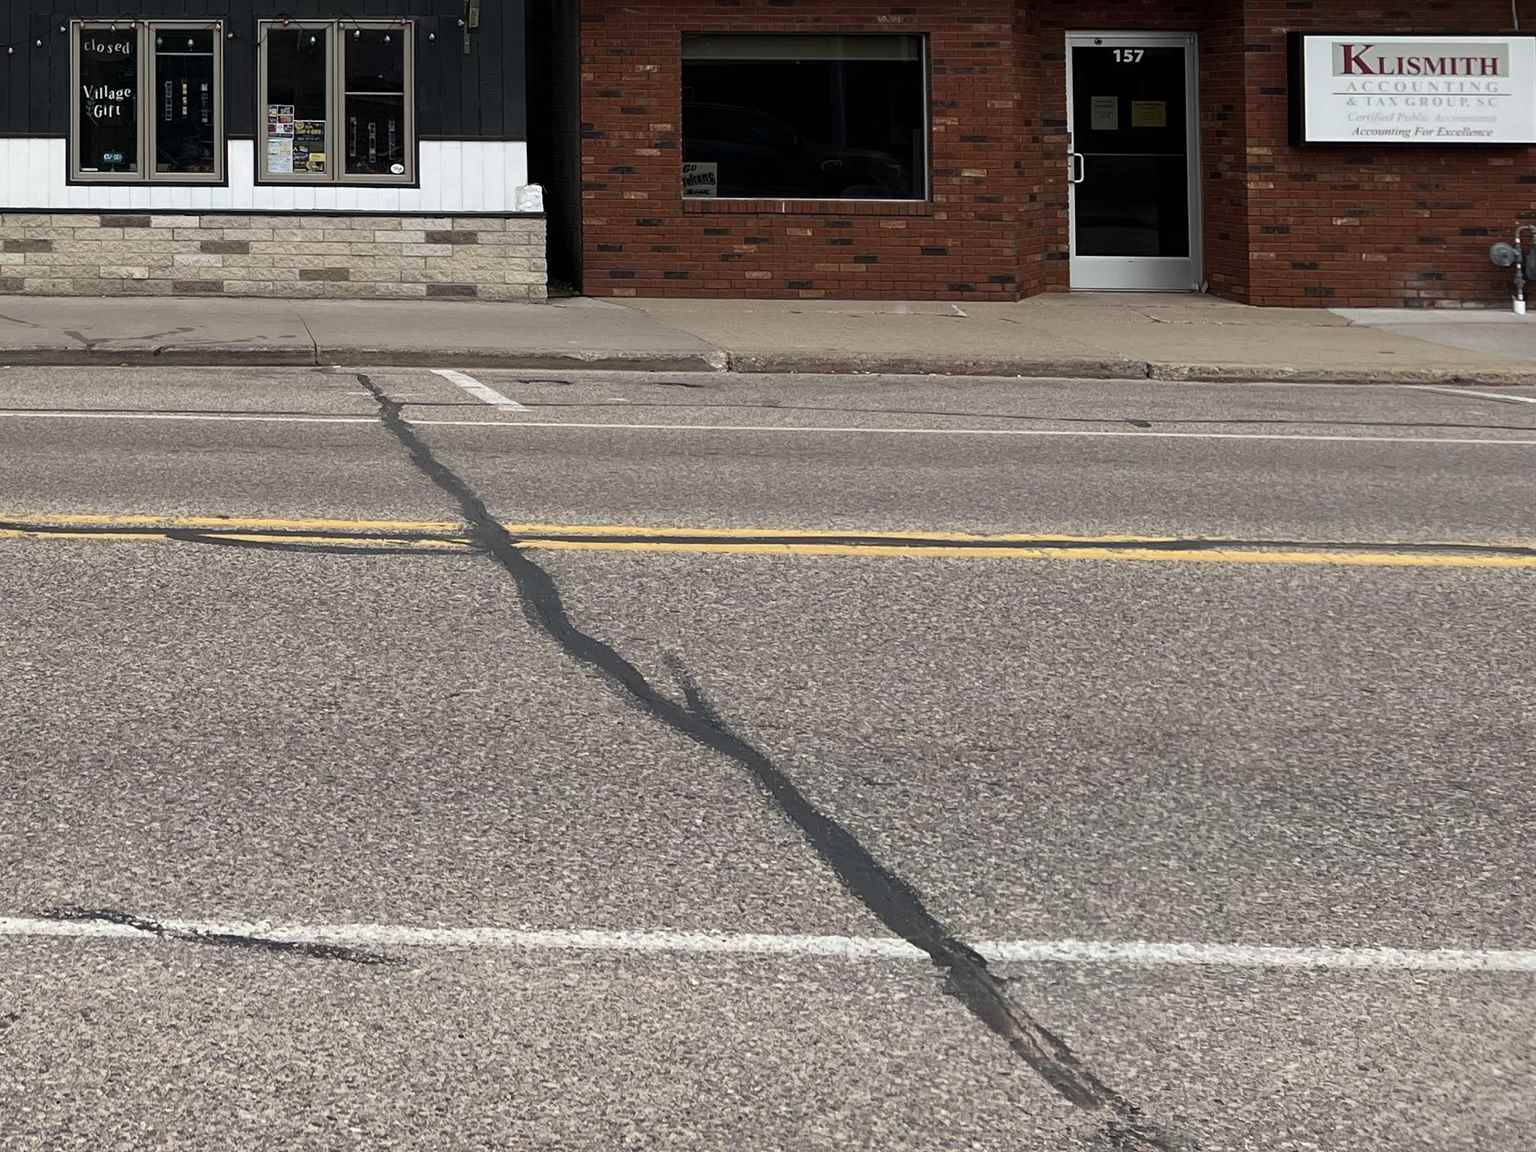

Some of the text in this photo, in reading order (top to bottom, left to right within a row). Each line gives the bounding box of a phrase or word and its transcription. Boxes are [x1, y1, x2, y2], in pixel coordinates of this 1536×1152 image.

[83, 37, 131, 55] closed
[1113, 49, 1145, 63] 157
[1339, 44, 1500, 76] KLISMITH
[83, 84, 133, 101] Village
[1346, 80, 1500, 94] ACCOUNTING
[1346, 97, 1358, 107] &
[1366, 96, 1400, 108] TAX
[93, 104, 122, 119] Gift
[1352, 126, 1495, 139] Accounting For Excellence
